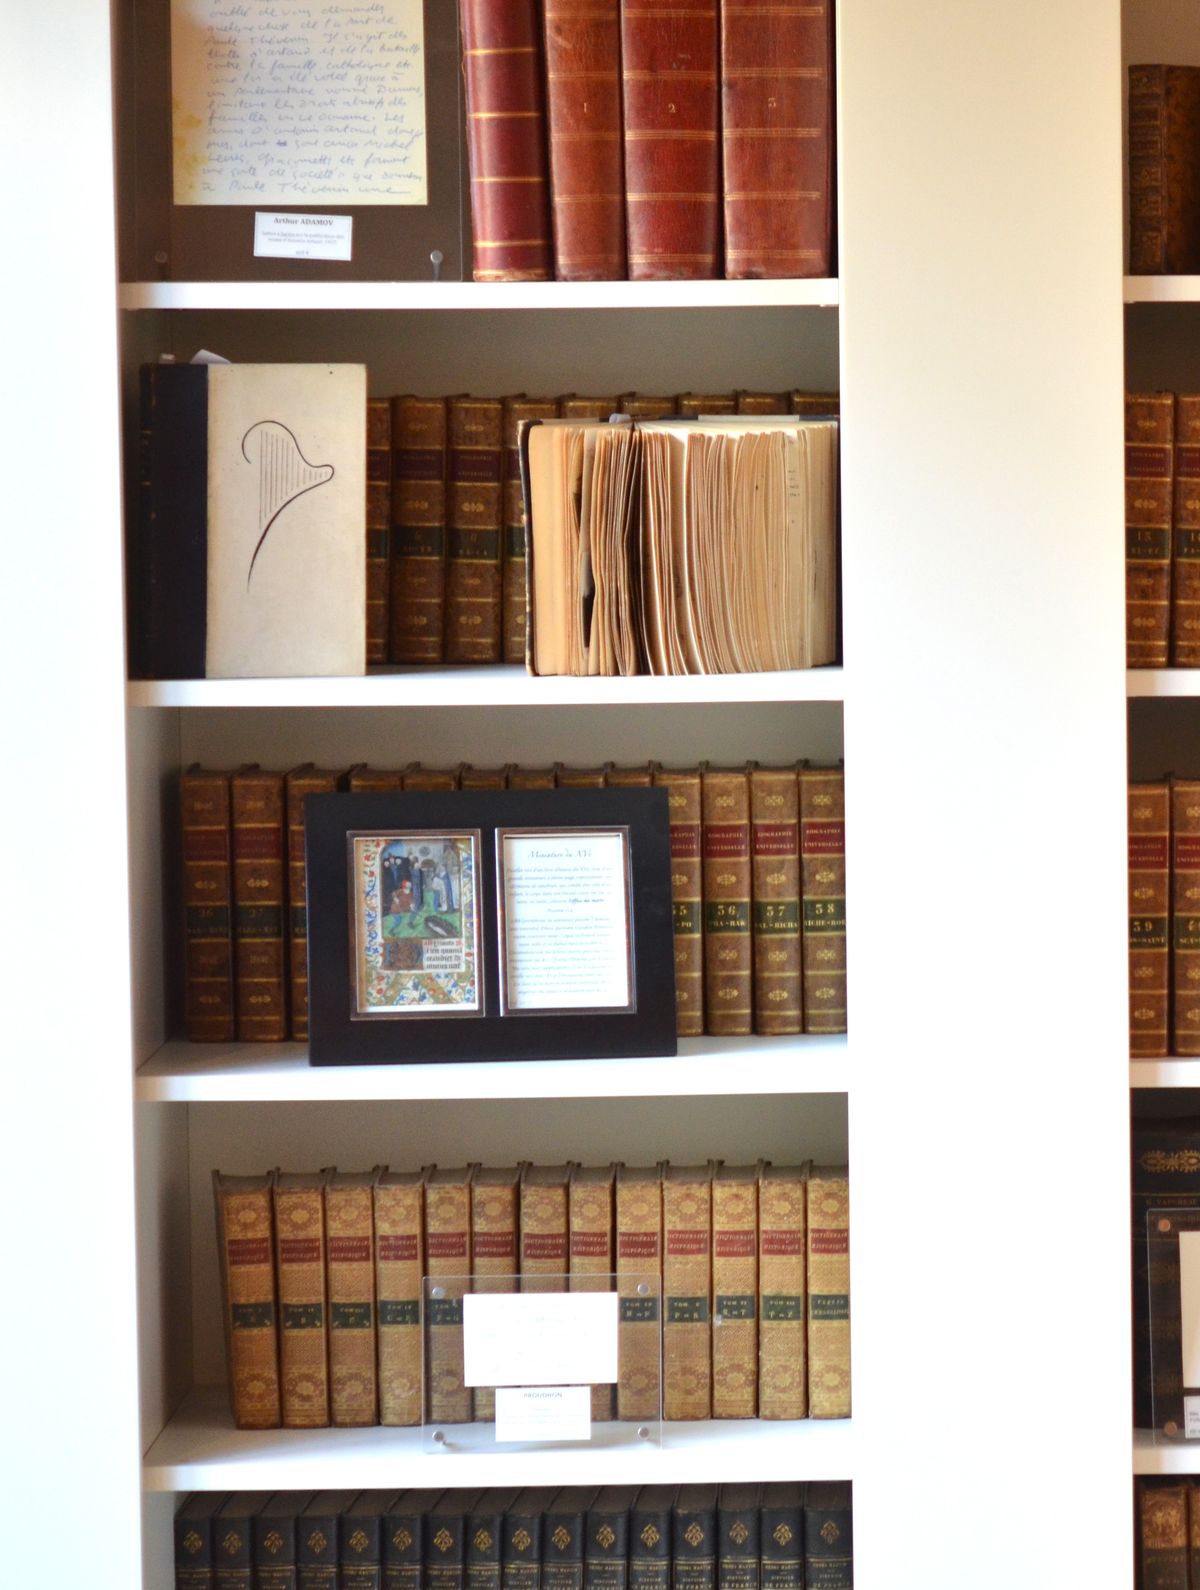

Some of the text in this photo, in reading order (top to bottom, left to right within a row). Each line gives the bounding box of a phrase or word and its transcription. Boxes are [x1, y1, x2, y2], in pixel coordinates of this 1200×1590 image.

[667, 103, 676, 114] 2
[273, 217, 334, 226] Arthur ADAMOV
